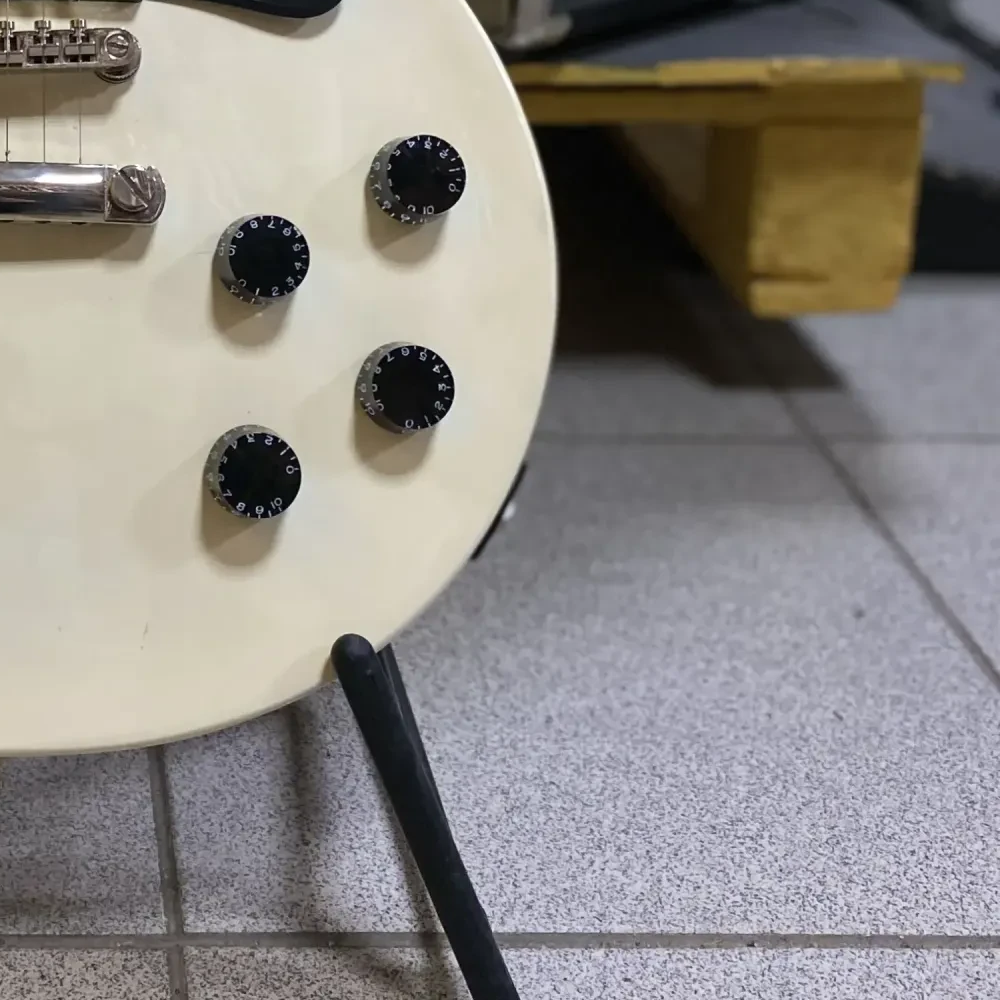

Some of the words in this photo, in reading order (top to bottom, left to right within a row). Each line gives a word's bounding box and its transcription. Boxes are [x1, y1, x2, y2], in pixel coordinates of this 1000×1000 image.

[249, 220, 259, 229] 8
[235, 502, 246, 511] 8
[270, 497, 283, 510] 10
[255, 505, 265, 515] 9
